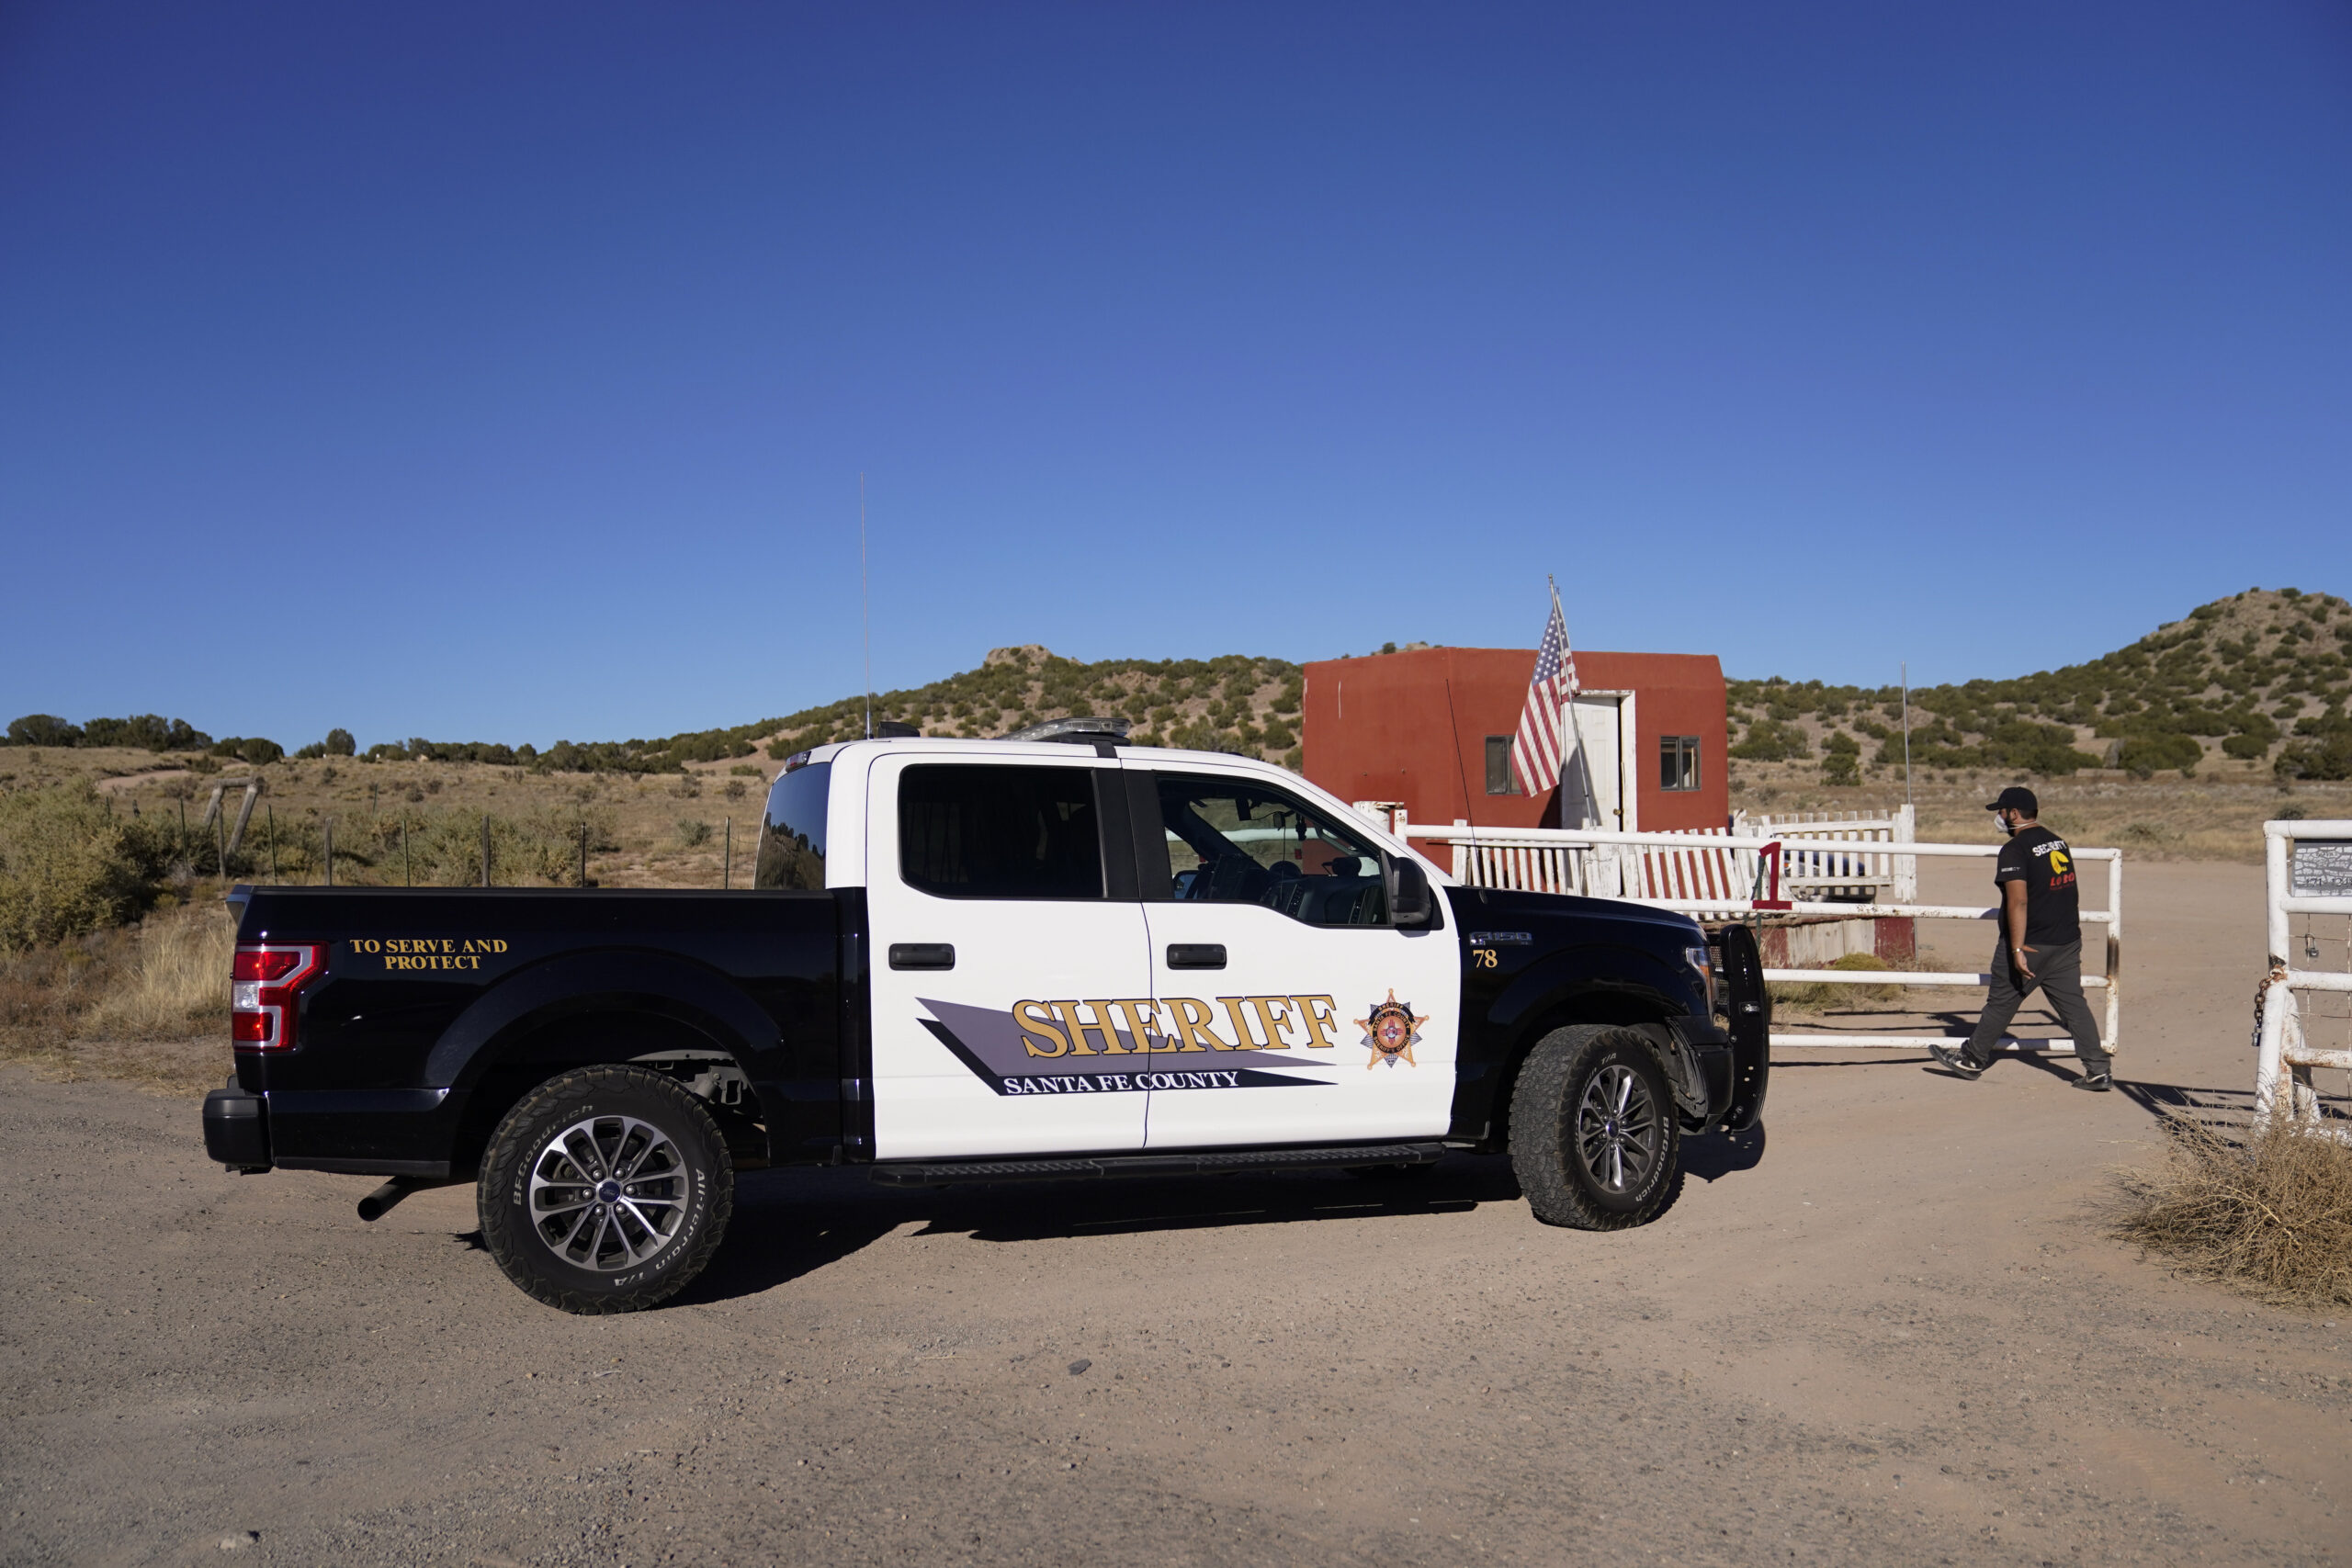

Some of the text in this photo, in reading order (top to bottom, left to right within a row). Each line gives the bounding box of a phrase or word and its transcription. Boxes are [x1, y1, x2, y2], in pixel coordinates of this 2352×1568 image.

[1752, 841, 1792, 910] 1
[349, 939, 508, 953] TO SERVE AND
[383, 955, 481, 970] PROTECT
[1473, 949, 1498, 968] 78
[1012, 994, 1338, 1059] SHERIFF
[1003, 1071, 1239, 1095] SANTA FE COUNTY
